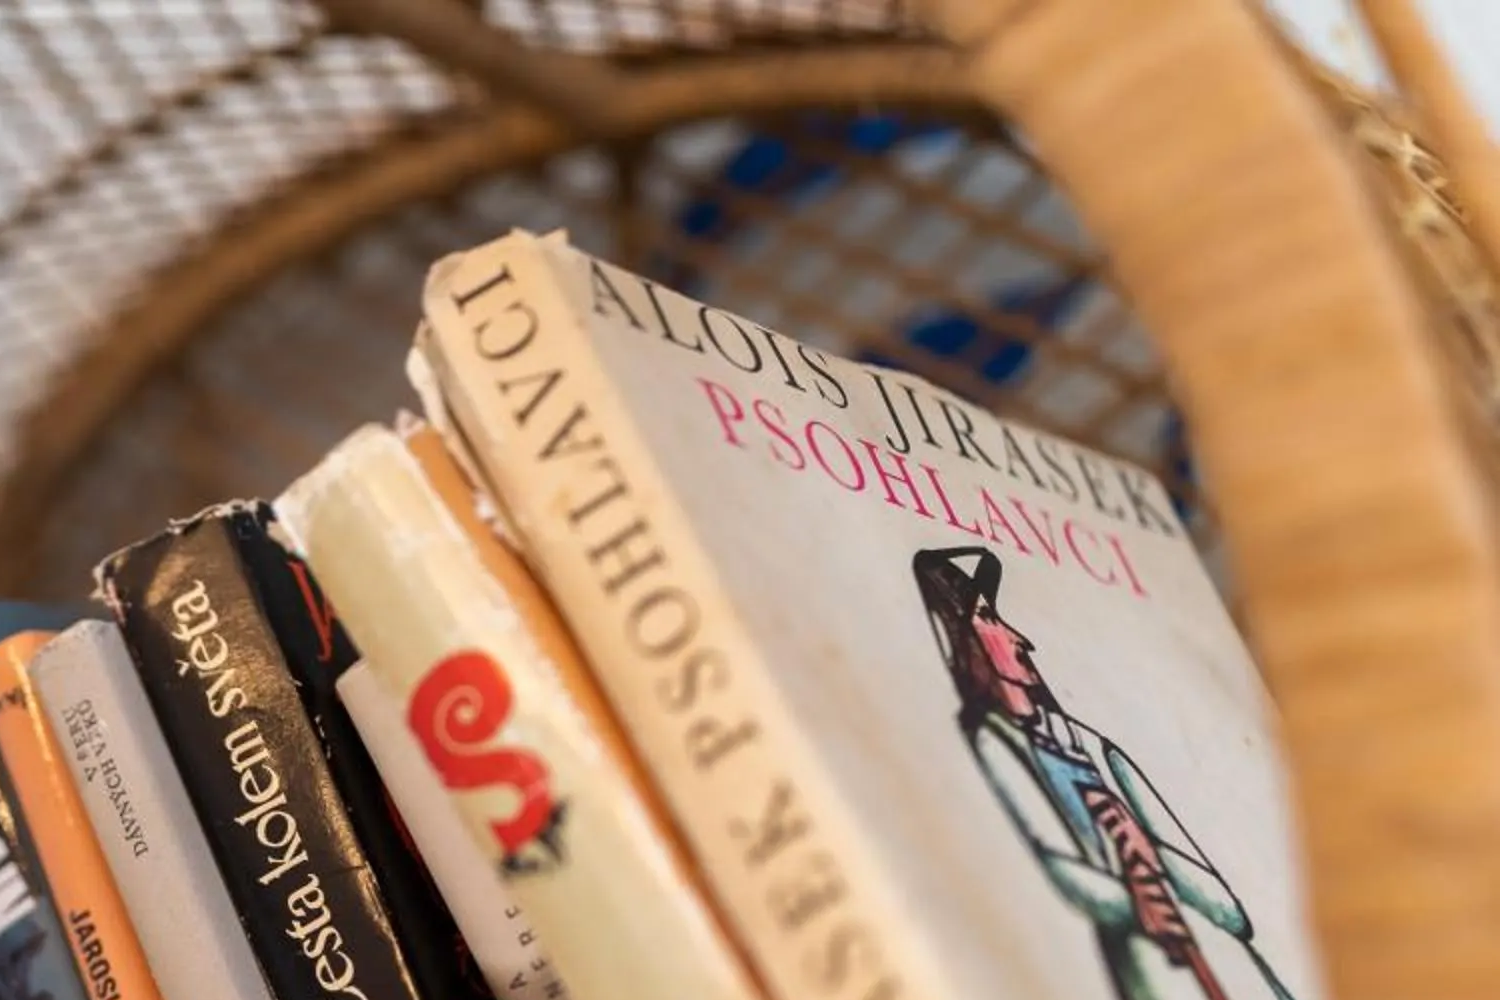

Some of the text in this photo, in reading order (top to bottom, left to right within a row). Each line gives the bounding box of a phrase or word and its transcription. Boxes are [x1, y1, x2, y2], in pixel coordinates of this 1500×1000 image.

[590, 261, 848, 409] ALOIS
[453, 263, 762, 772] PSOHLAVCI
[695, 377, 1148, 598] PSOHLAVCI
[171, 579, 248, 718] světa
[223, 718, 309, 886] kolem
